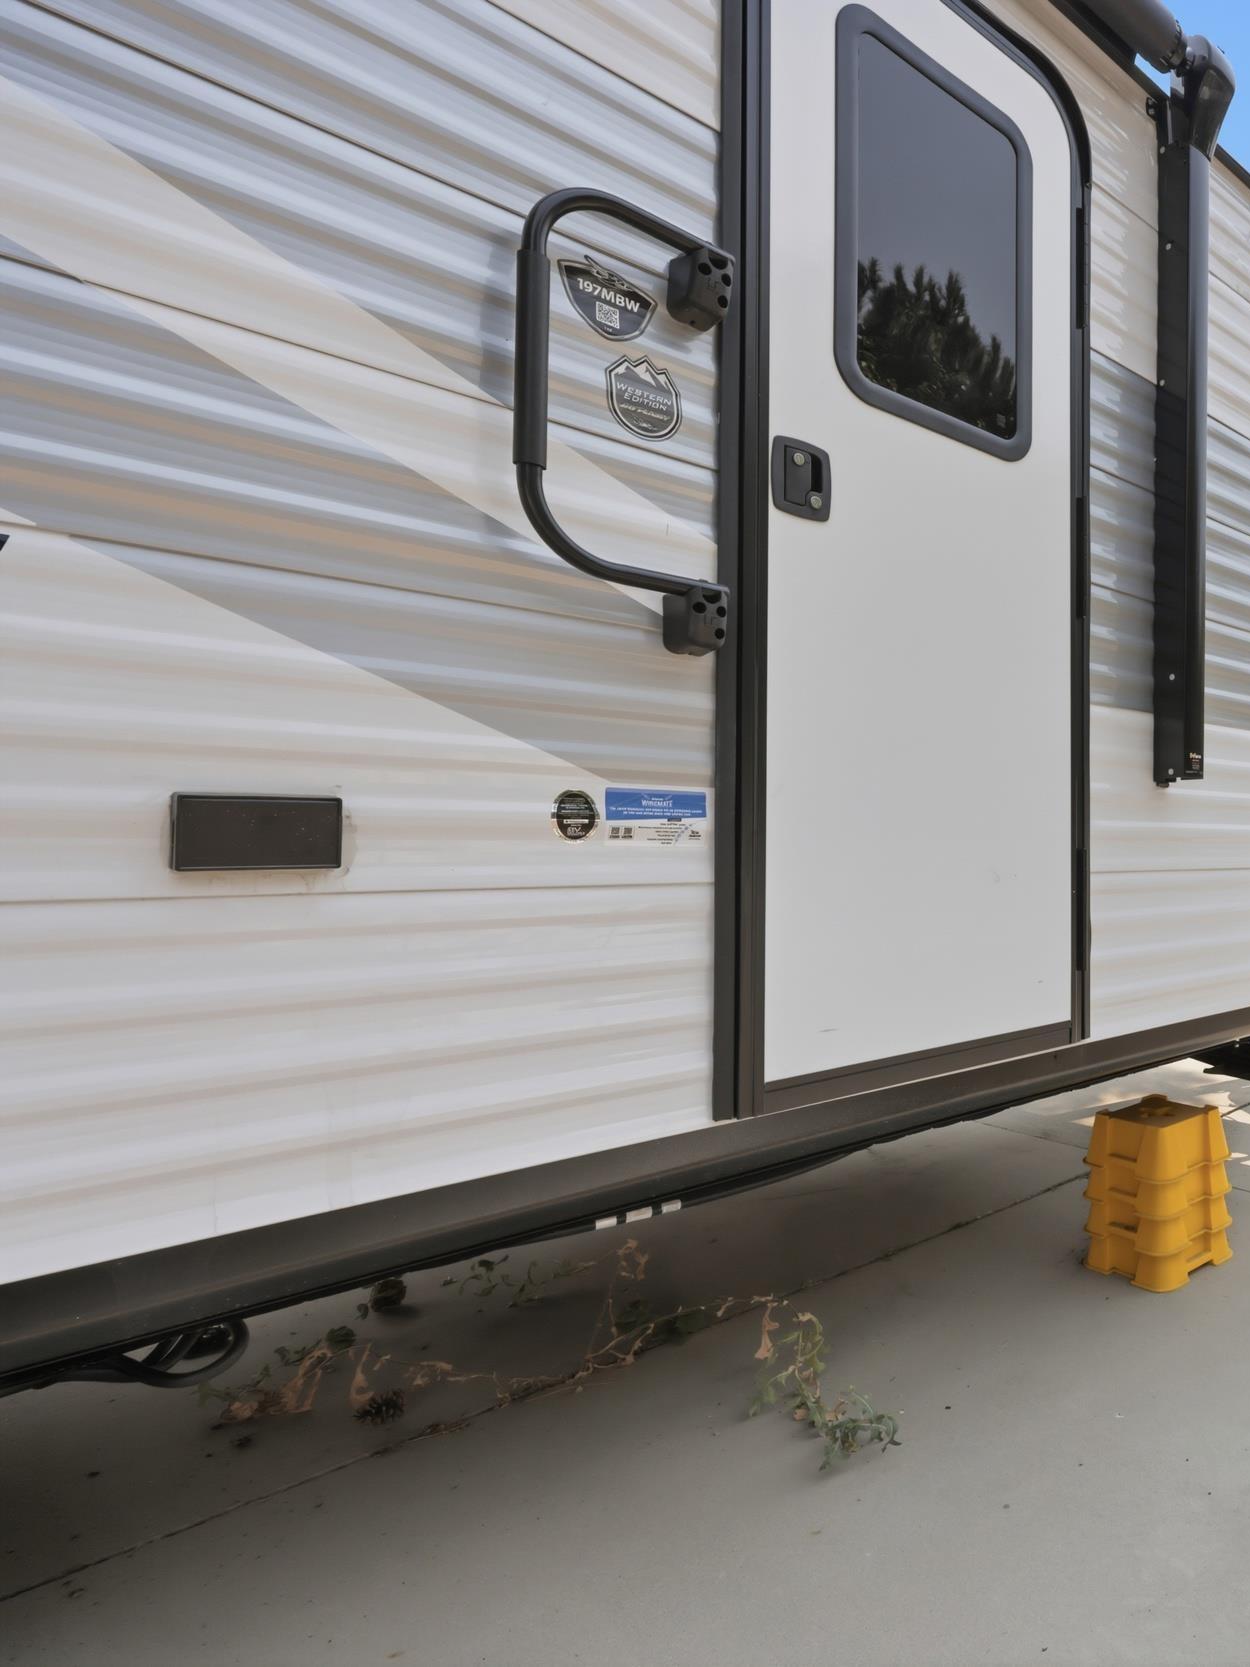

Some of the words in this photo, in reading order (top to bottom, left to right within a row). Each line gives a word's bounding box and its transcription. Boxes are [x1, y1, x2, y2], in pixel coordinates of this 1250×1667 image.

[576, 277, 641, 313] 197MBW
[616, 381, 672, 406] WESTERN
[623, 391, 668, 411] EDITION
